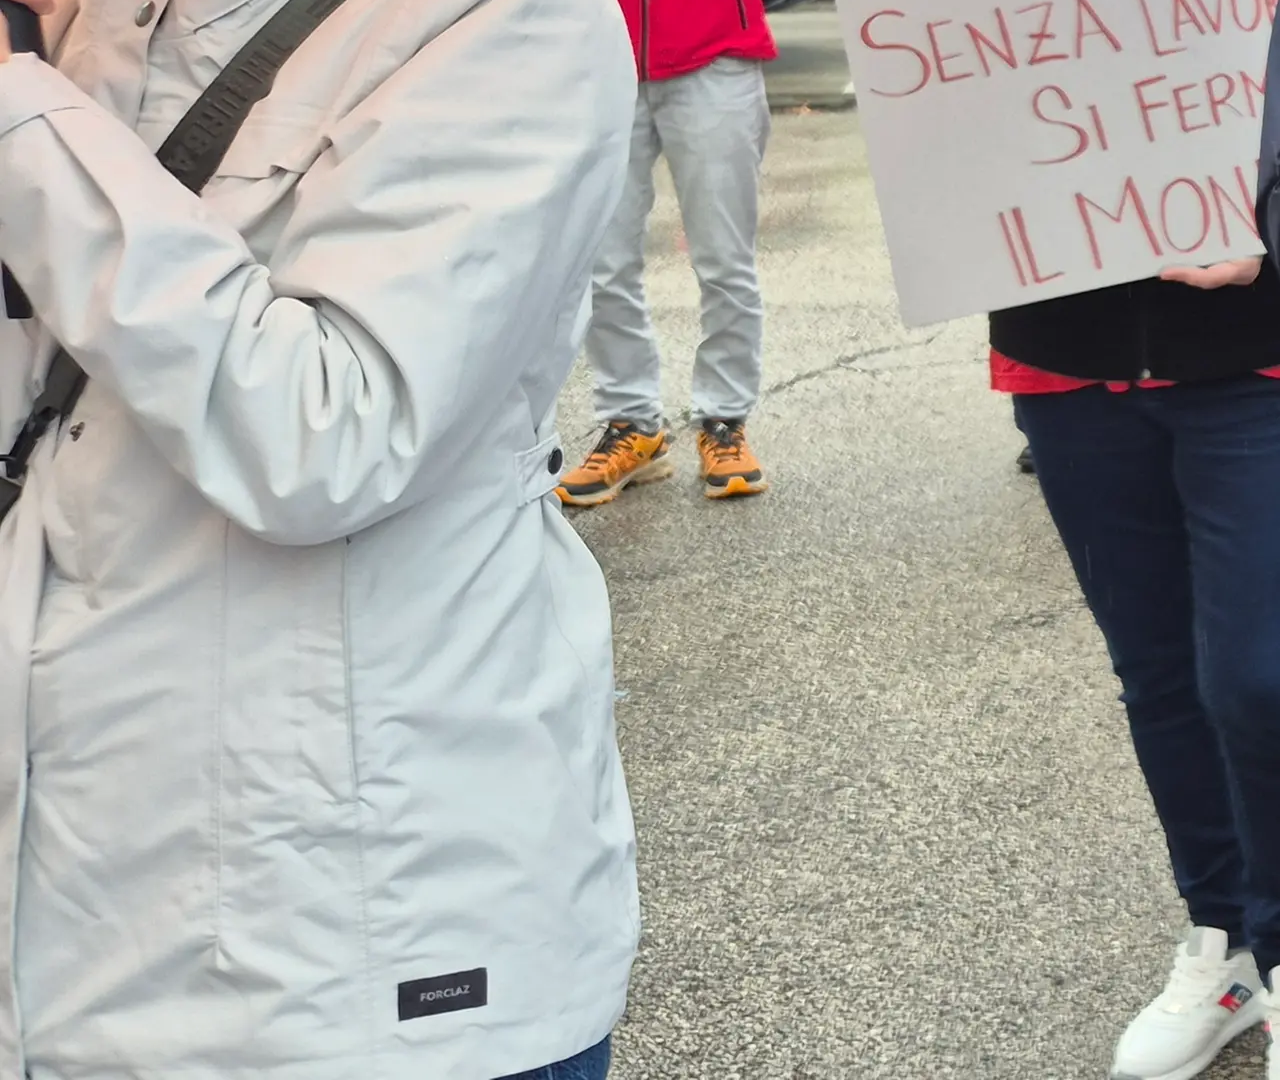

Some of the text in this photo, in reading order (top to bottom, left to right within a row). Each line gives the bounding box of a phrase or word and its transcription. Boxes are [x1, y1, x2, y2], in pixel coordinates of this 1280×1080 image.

[998, 159, 1261, 287] IL MON
[420, 985, 471, 1002] FORCLAZ
